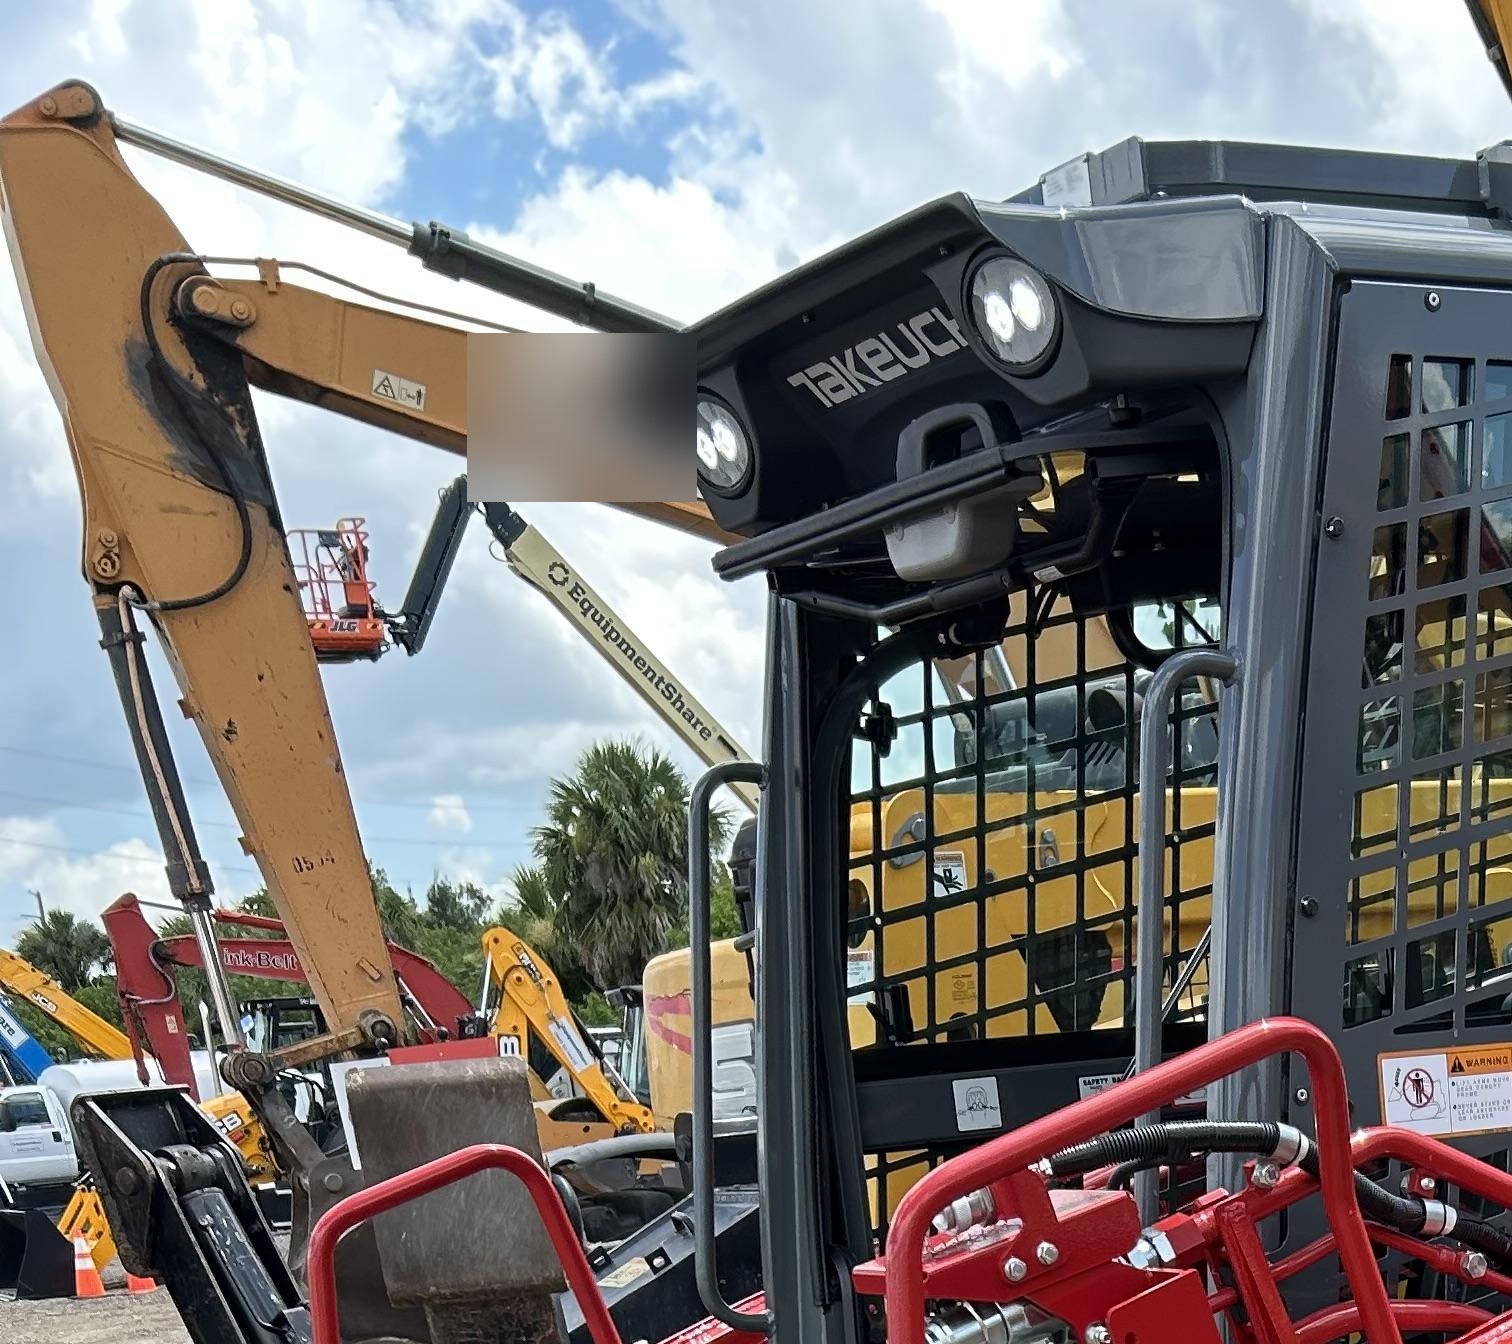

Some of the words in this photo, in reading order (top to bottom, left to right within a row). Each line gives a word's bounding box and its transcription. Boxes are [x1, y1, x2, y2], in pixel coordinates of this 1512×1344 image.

[330, 621, 357, 632] JLG
[567, 582, 712, 741] EquipmentShare
[223, 947, 298, 971] ink-Belt
[1466, 1056, 1508, 1068] WARNING
